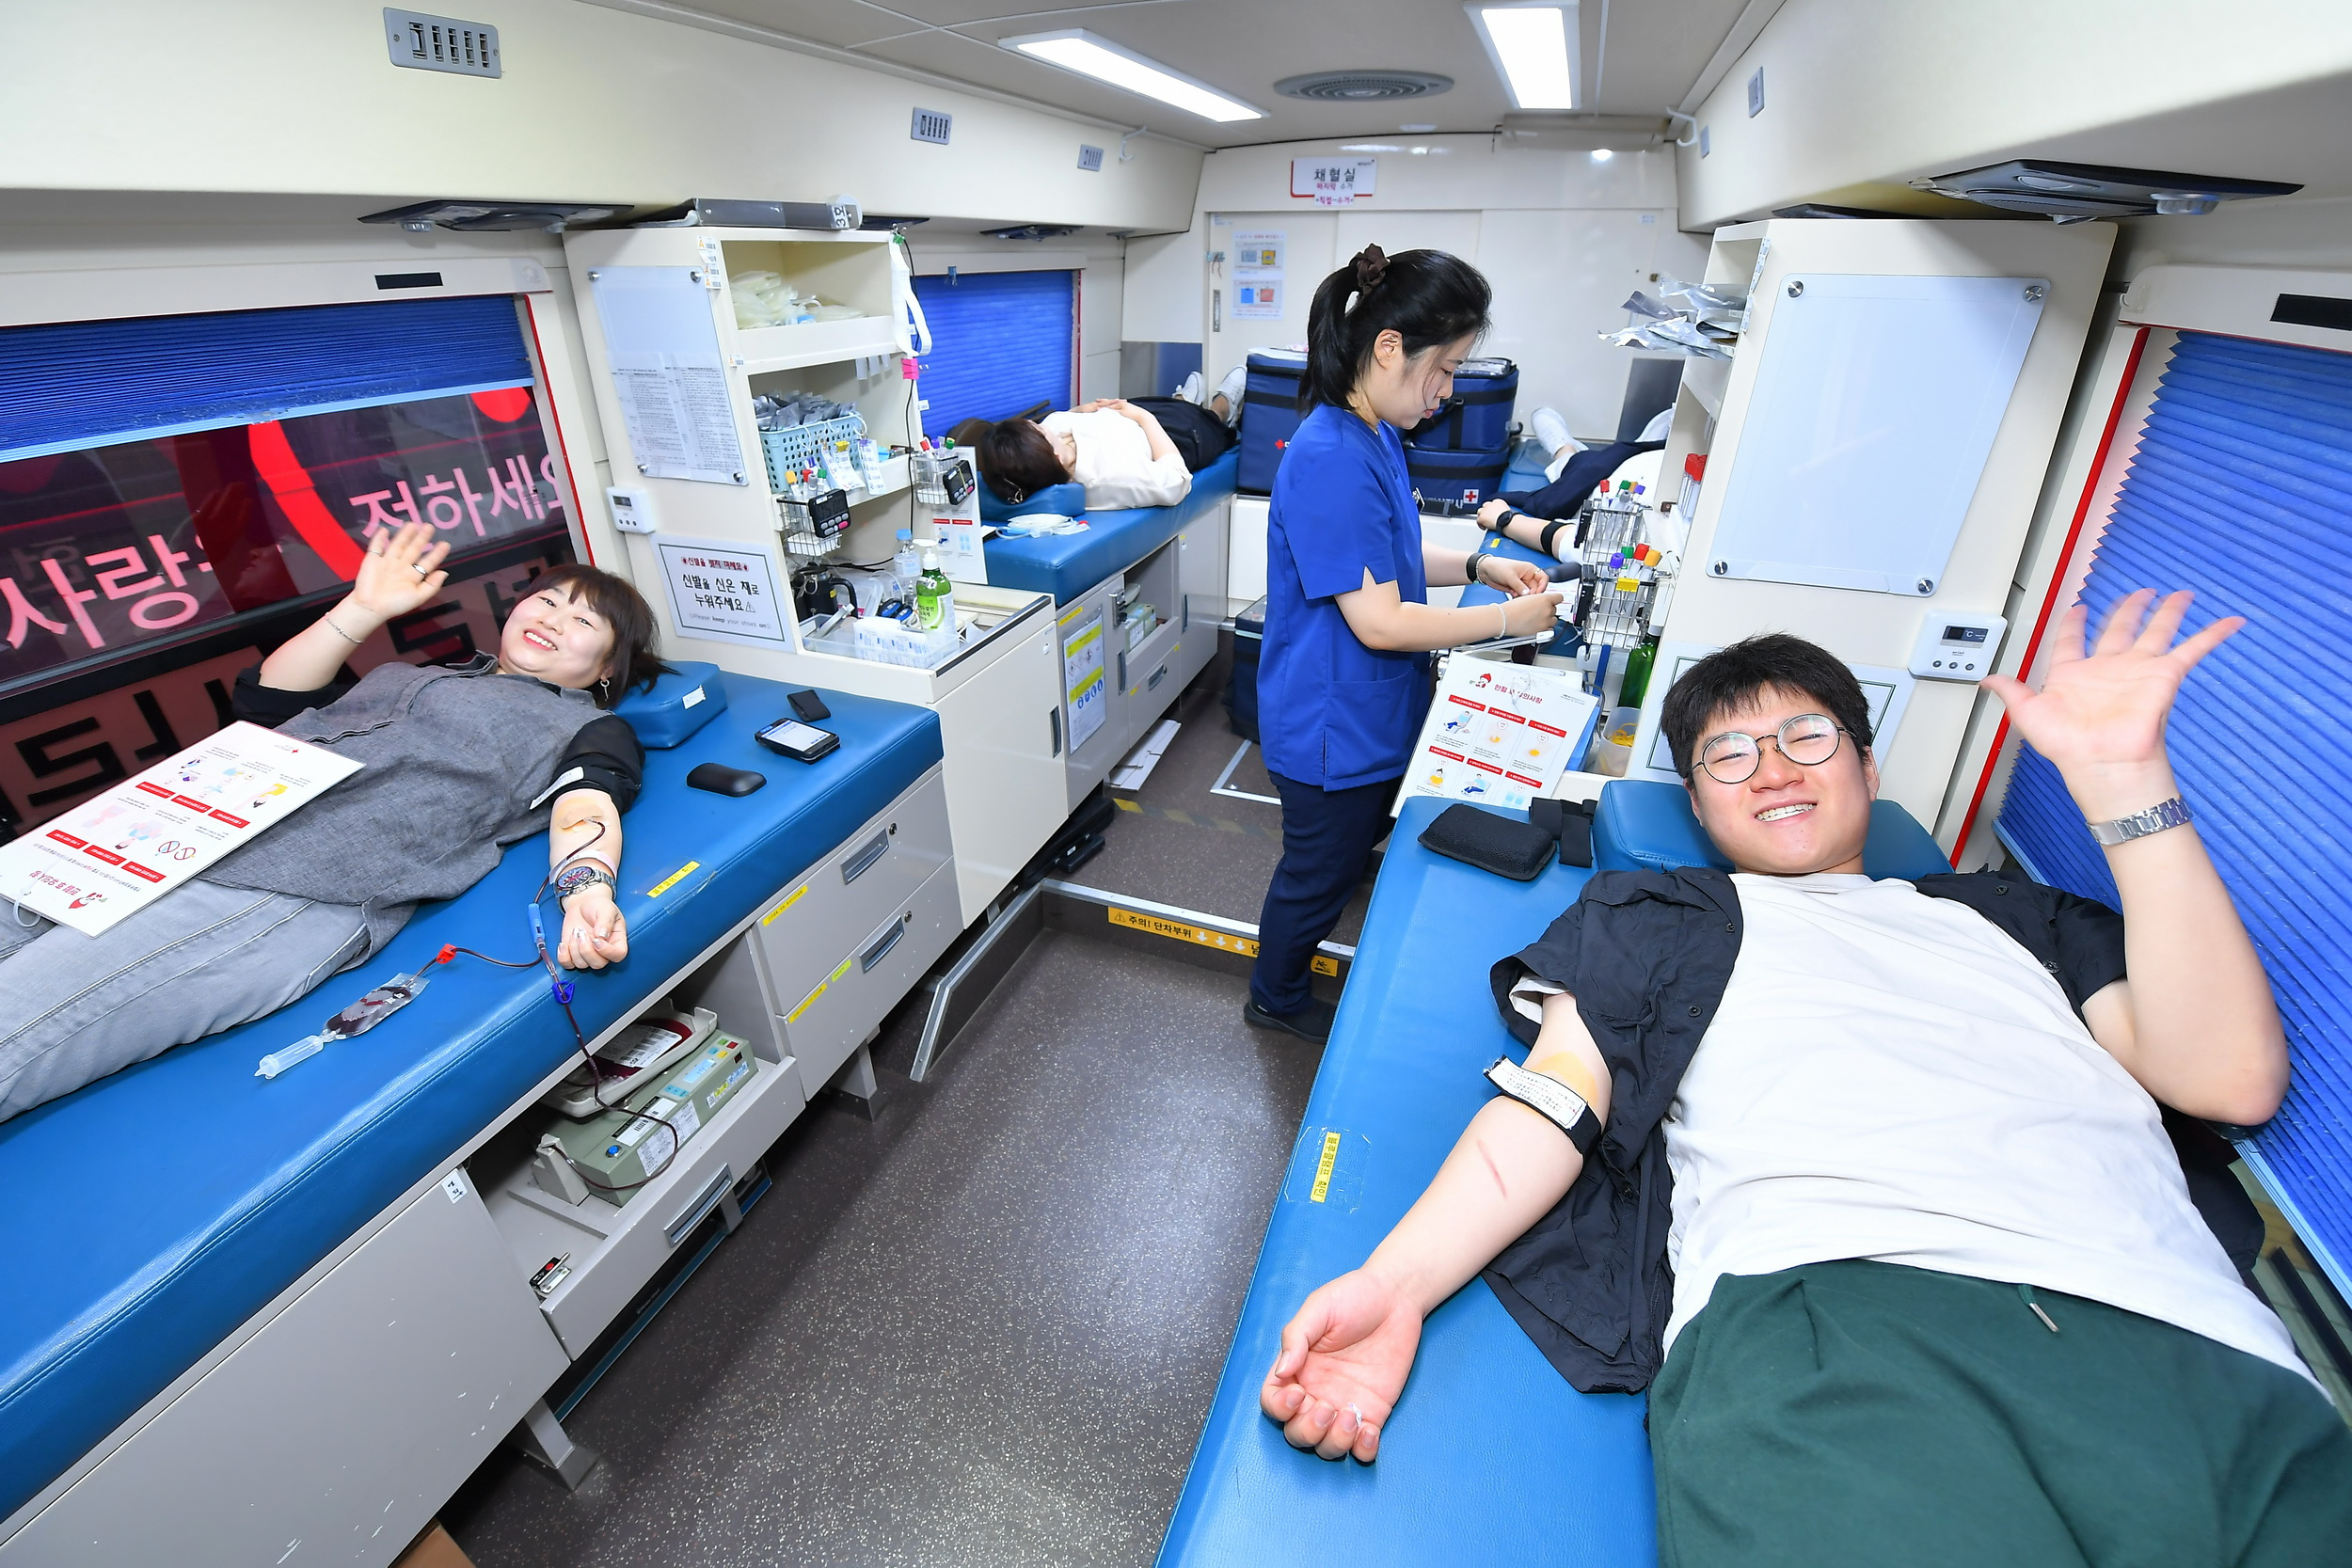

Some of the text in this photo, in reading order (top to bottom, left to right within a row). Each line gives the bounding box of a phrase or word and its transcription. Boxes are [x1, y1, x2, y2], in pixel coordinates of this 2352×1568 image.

[1313, 167, 1356, 182] 채혈실
[0, 533, 215, 650] 사랑
[682, 574, 760, 595] 신발을 신은 채로
[694, 593, 744, 611] 누워주세요
[712, 615, 725, 624] keep
[1129, 915, 1151, 928] 주의!
[1153, 921, 1192, 939] 단차부위
